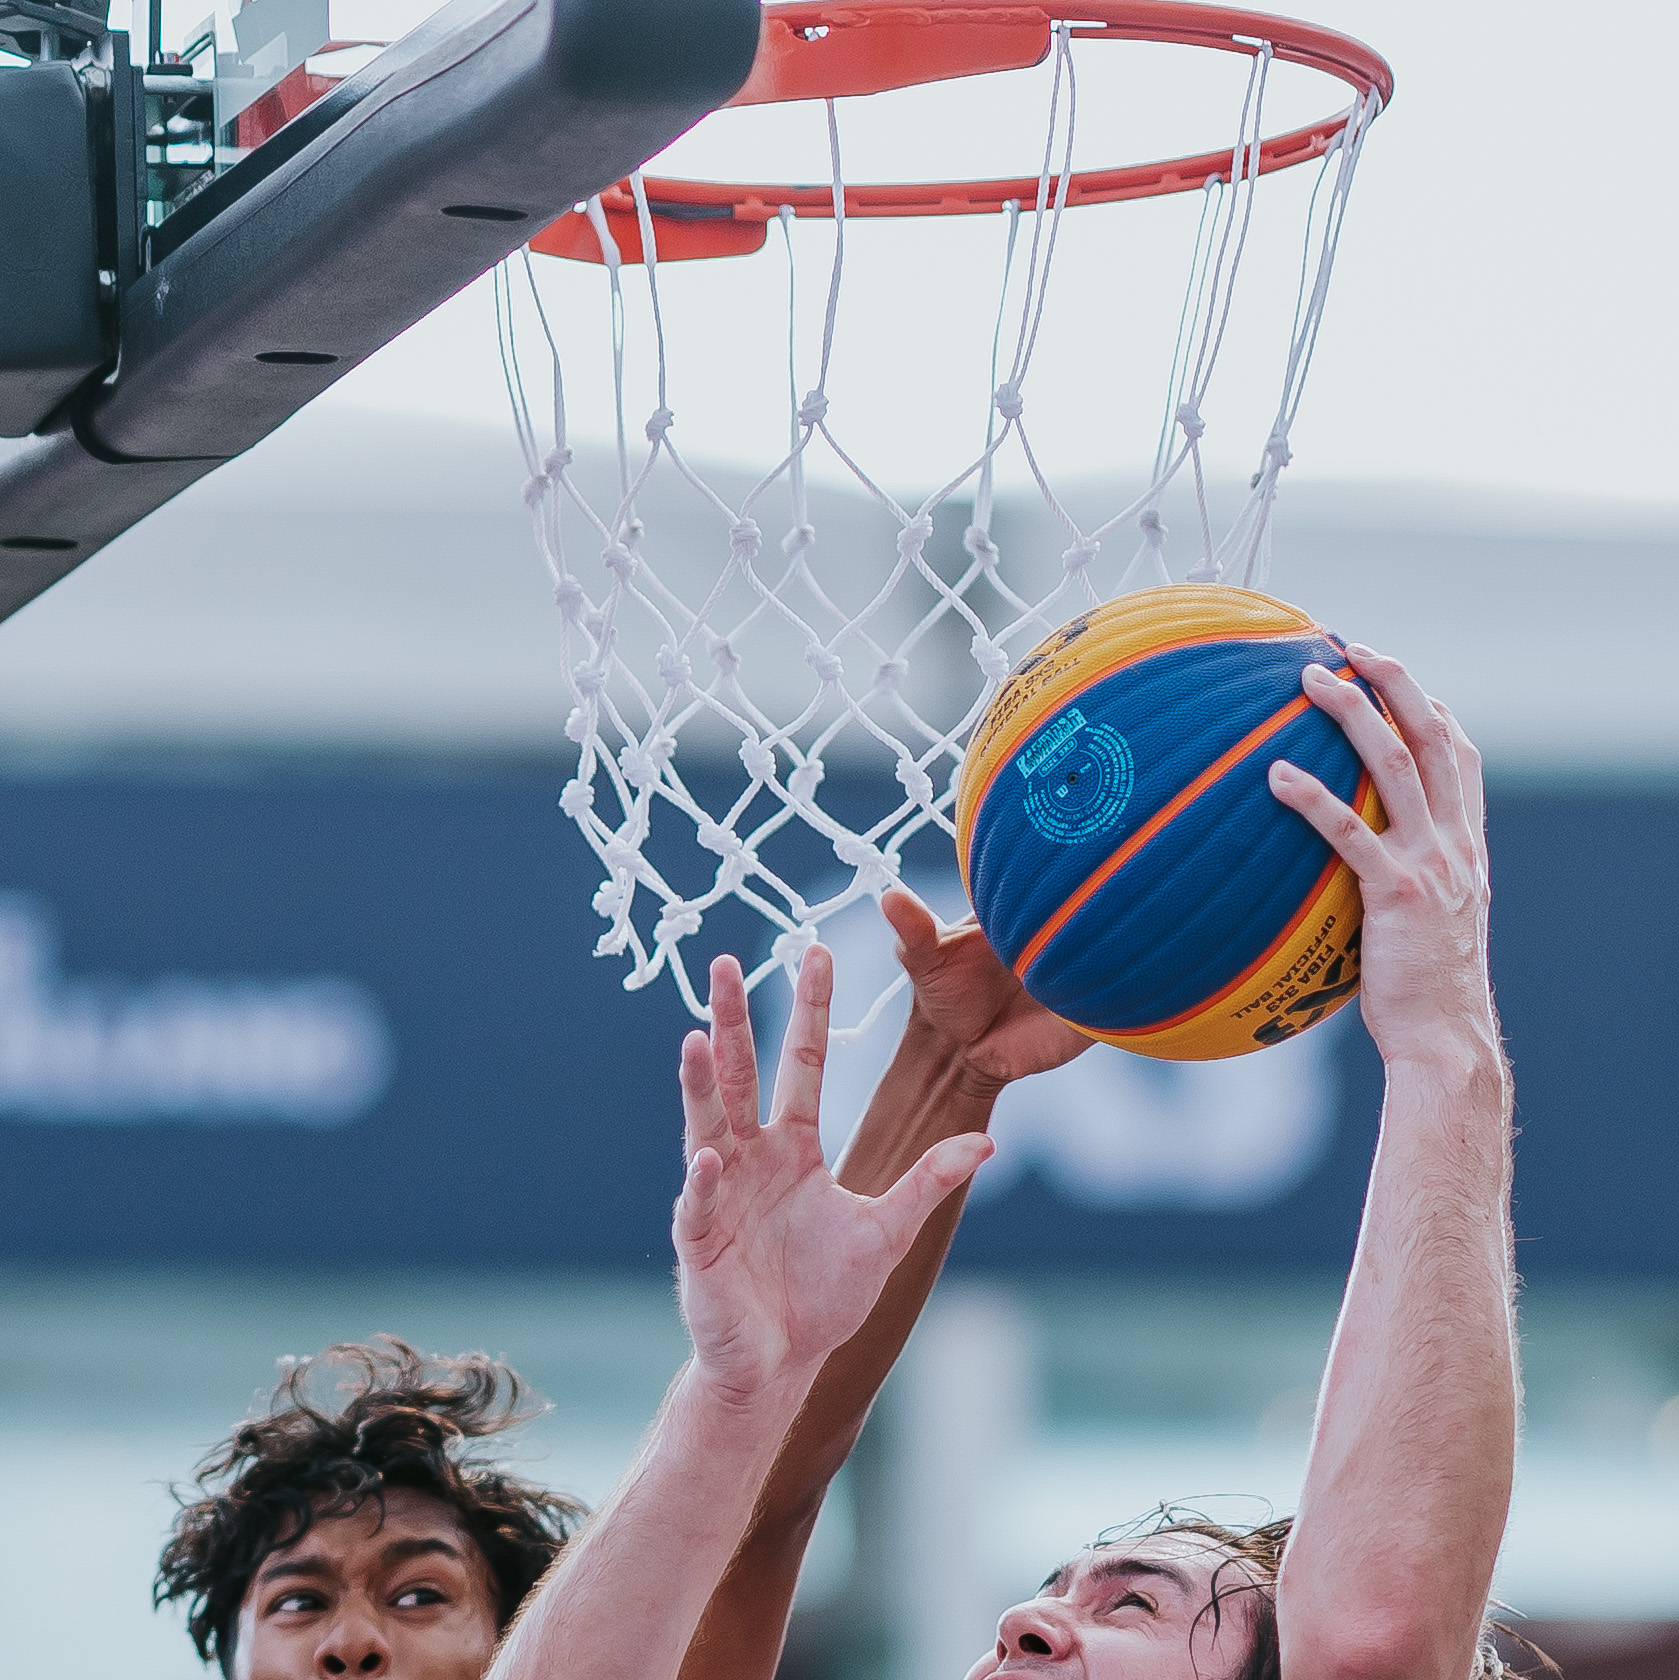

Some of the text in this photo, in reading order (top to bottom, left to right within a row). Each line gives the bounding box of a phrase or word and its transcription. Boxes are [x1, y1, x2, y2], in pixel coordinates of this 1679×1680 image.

[1229, 914, 1337, 1020] OFFICIAL BALL
[1296, 943, 1336, 985] FIBA
